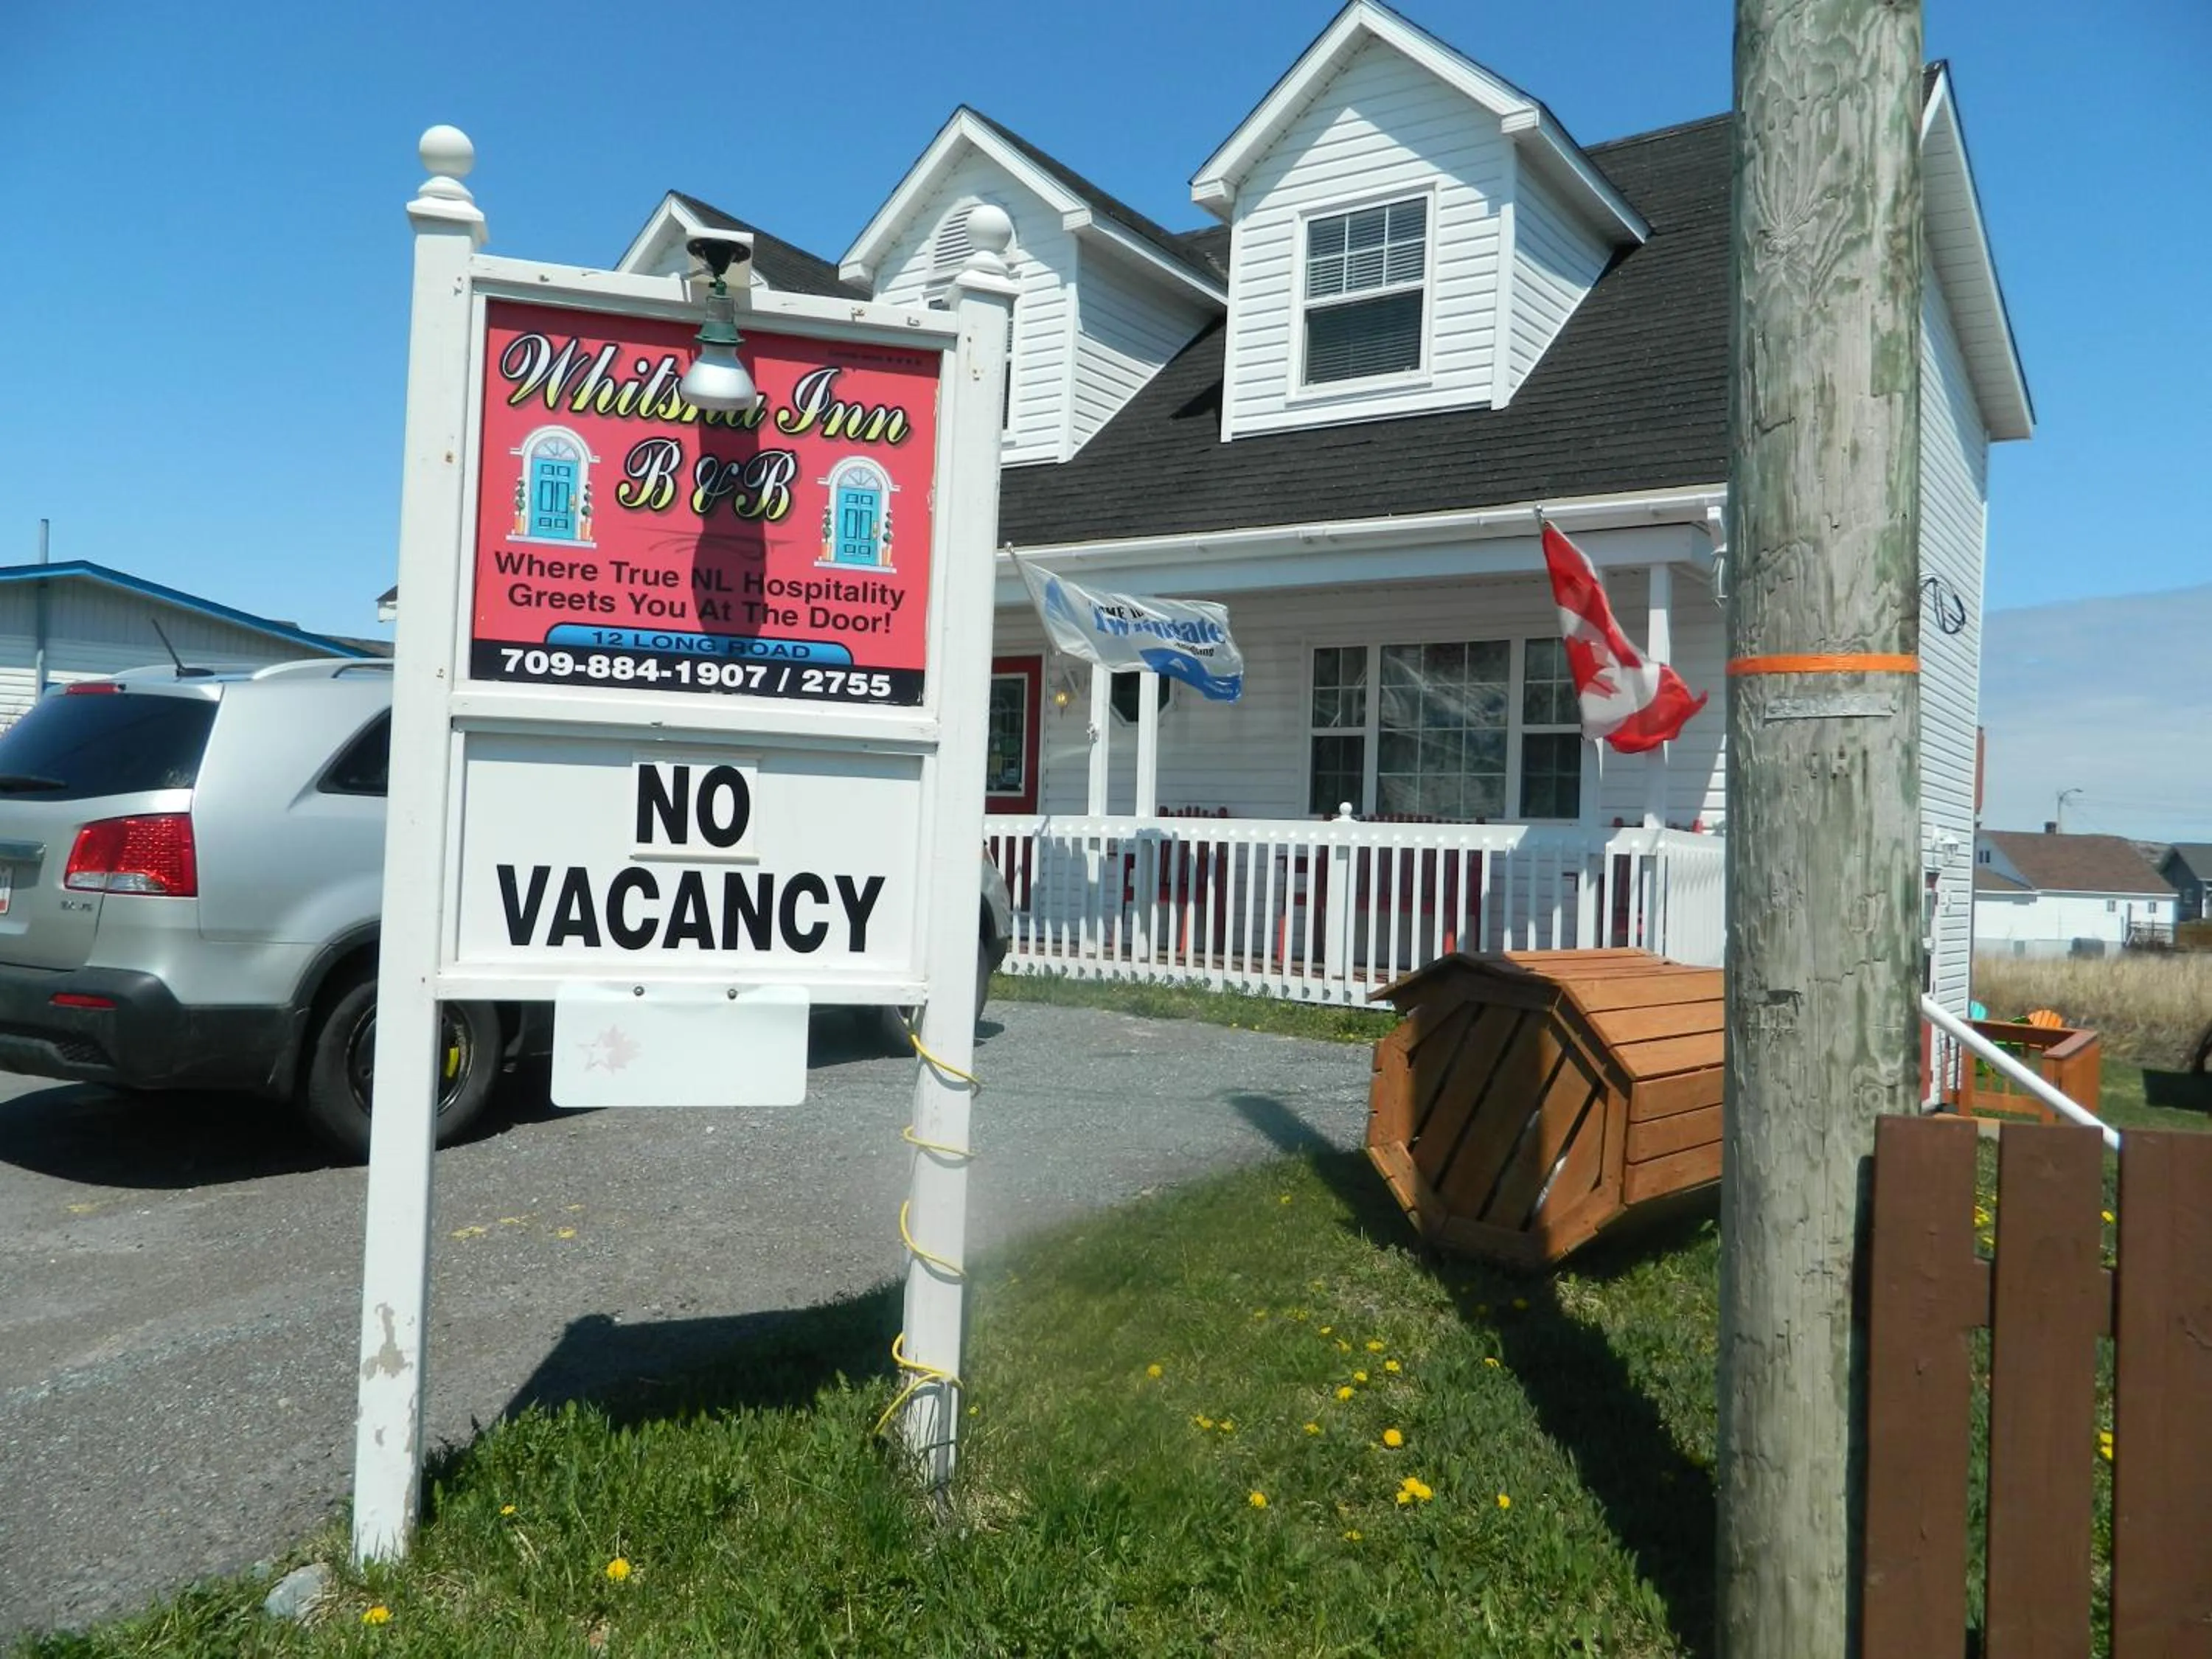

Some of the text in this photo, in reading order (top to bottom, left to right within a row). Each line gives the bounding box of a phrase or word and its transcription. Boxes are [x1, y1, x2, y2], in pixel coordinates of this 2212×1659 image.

[499, 332, 911, 444] Whits Inn
[615, 435, 799, 521] B & B
[495, 551, 905, 611] Where True NL Hospitality
[508, 583, 891, 633] Greets You At The Door!
[500, 647, 891, 697] 709-884-1907 / 2755
[592, 632, 810, 658] 12 LONG ROAD
[636, 764, 751, 848] NO
[496, 863, 886, 953] VACANCY
